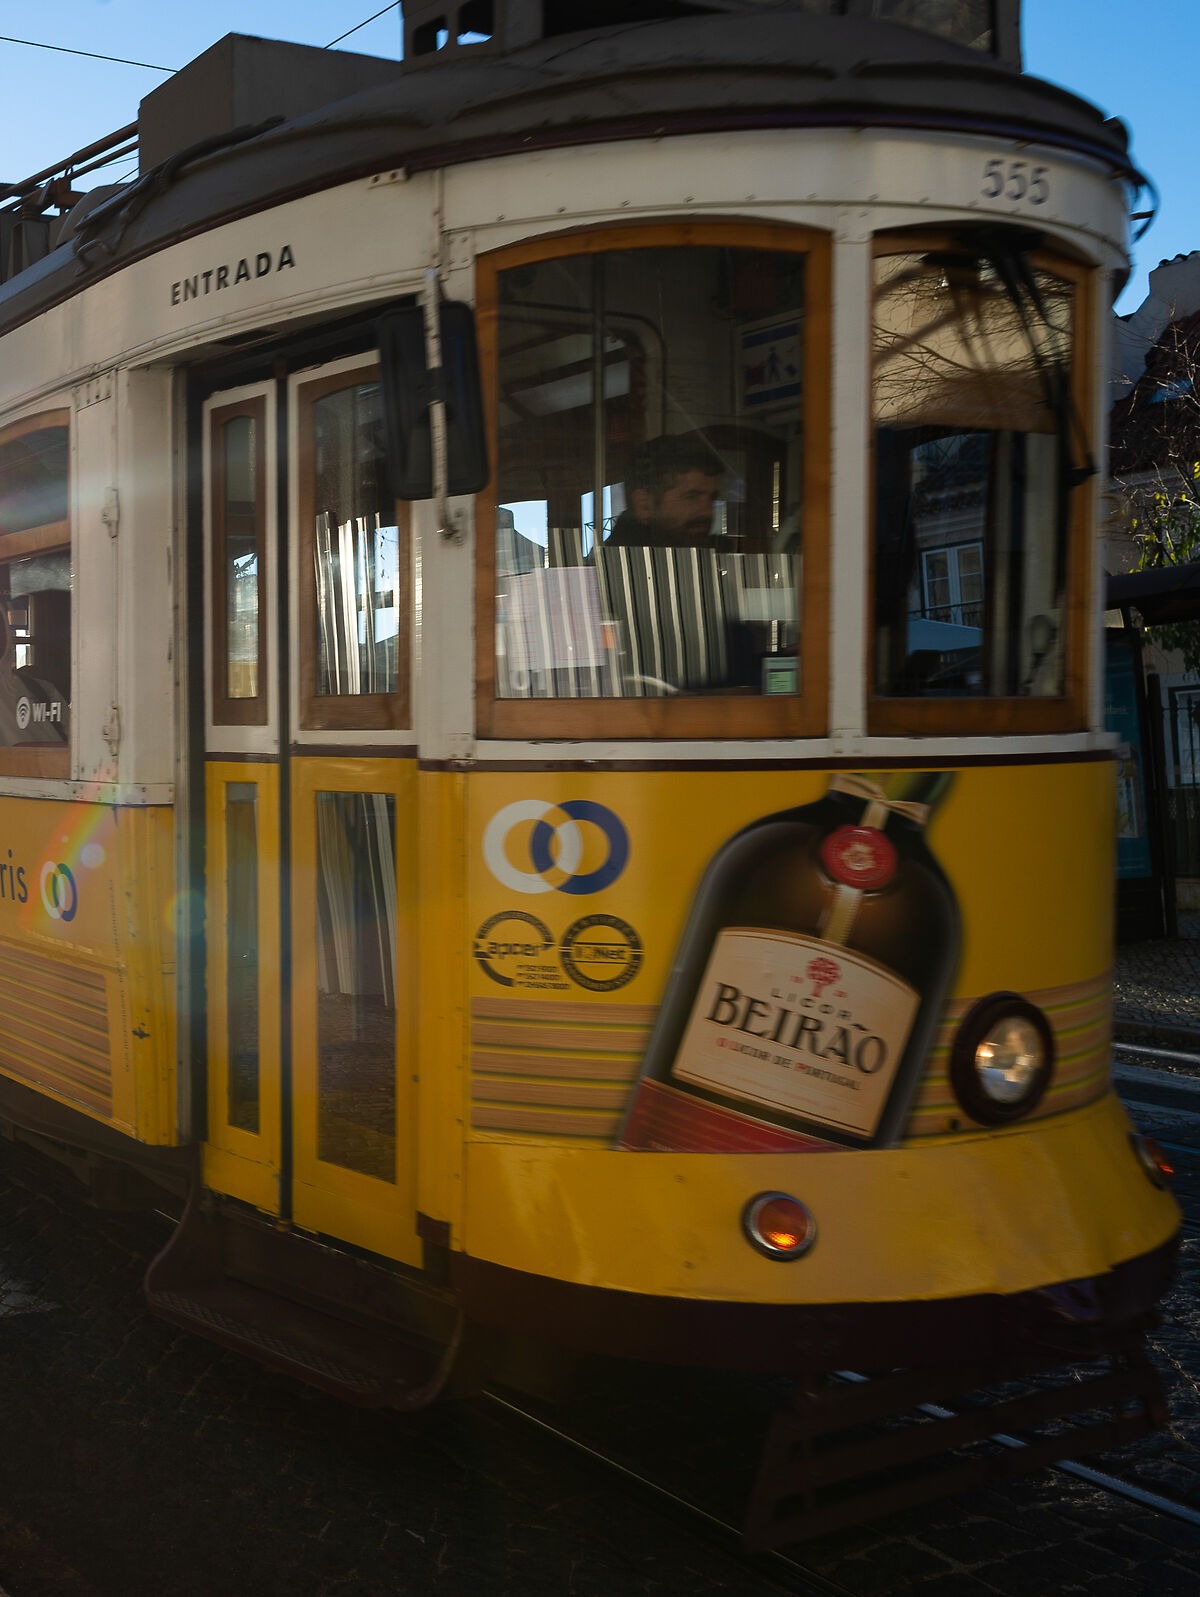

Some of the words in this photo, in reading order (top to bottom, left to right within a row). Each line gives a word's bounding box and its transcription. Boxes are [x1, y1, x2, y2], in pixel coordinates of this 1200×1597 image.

[980, 159, 1050, 206] 555
[170, 244, 296, 307] ENTRADA
[32, 702, 62, 723] WI-FI
[705, 981, 889, 1075] BEIRÃO
